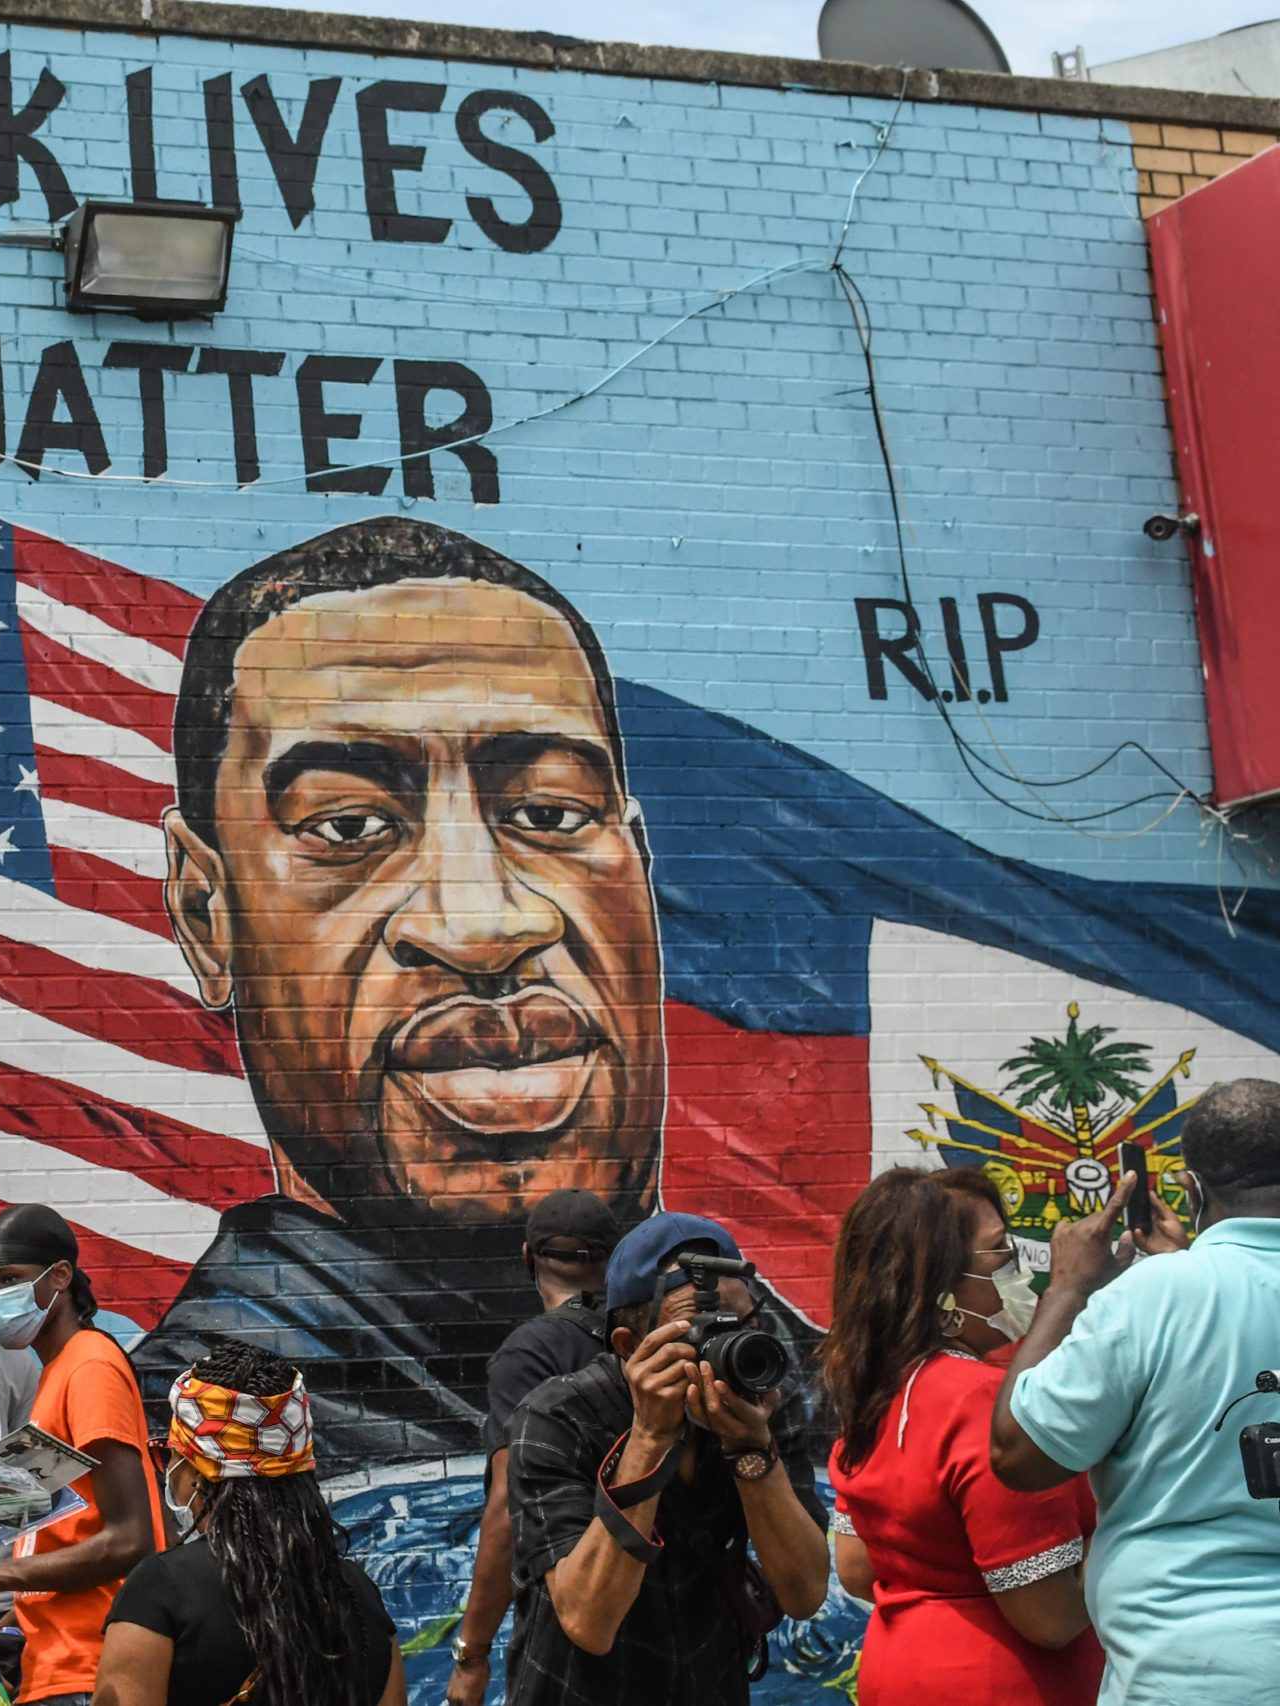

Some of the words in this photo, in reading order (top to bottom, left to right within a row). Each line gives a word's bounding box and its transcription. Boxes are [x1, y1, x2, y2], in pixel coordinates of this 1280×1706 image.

[126, 67, 562, 253] LIVES
[854, 591, 1041, 704] R.I.P
[1018, 1244, 1049, 1266] NIO
